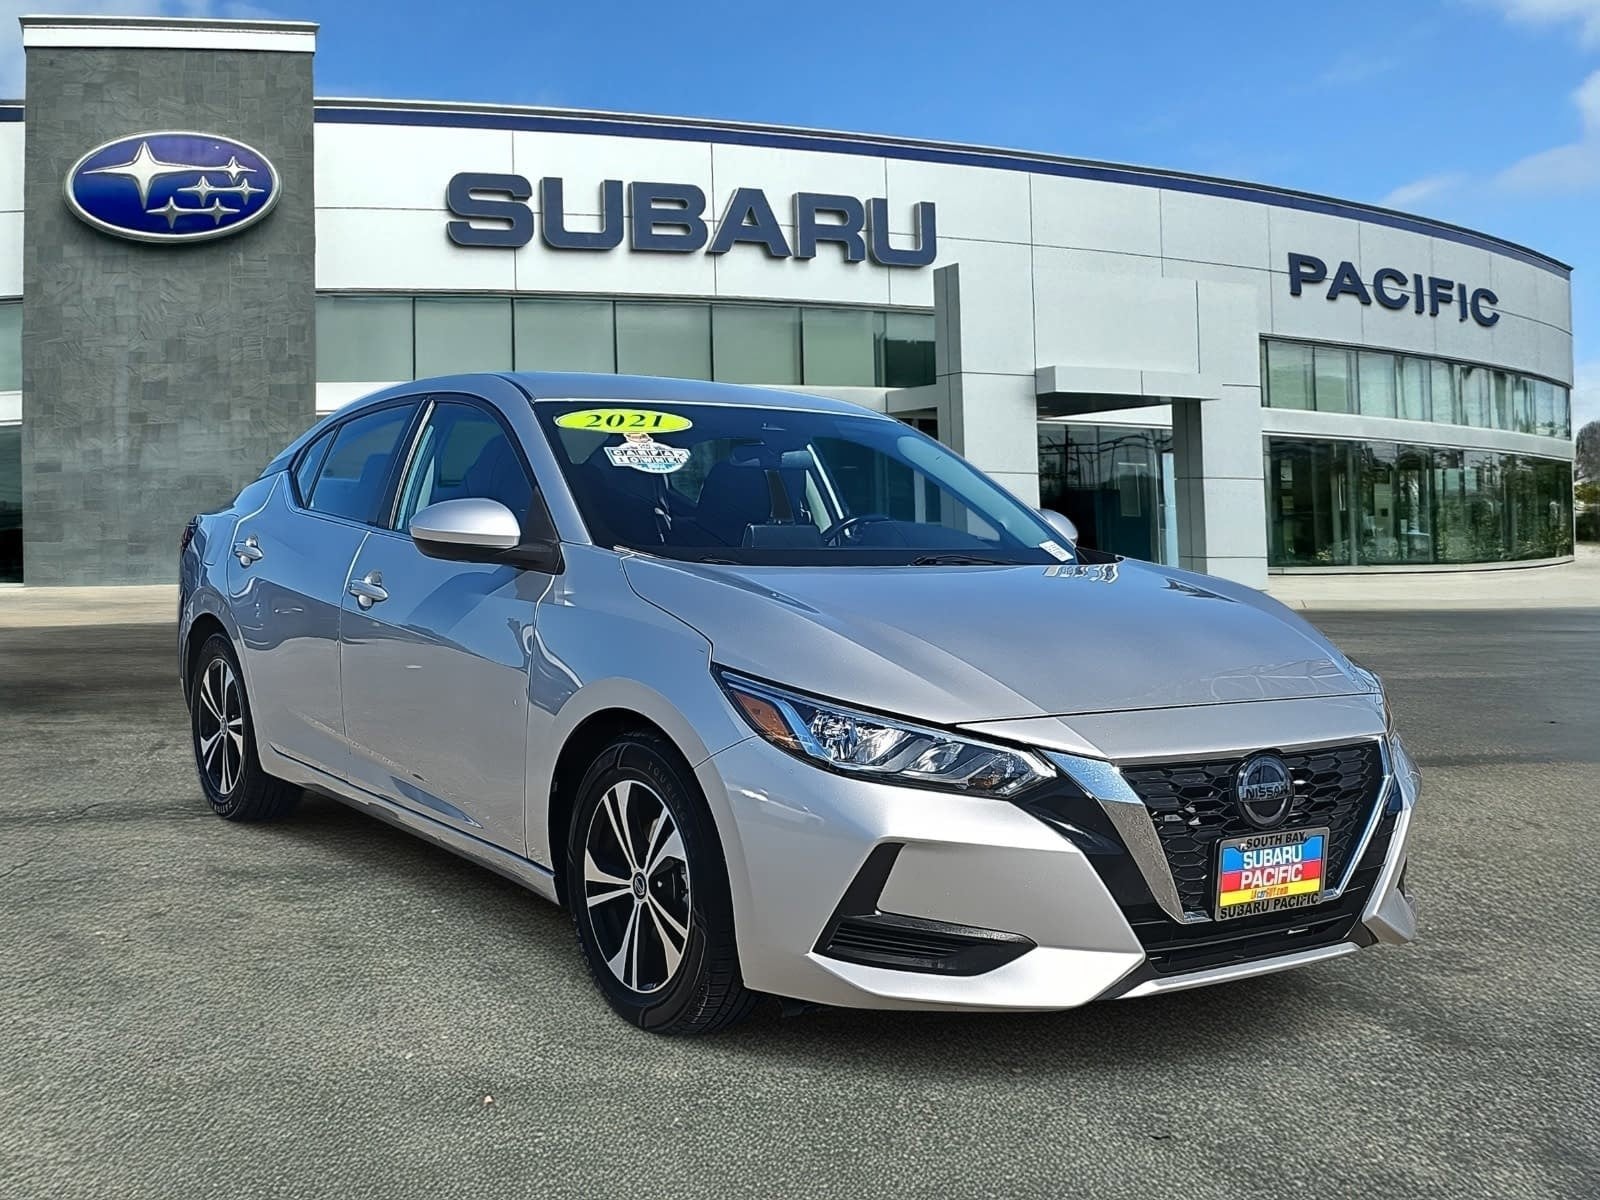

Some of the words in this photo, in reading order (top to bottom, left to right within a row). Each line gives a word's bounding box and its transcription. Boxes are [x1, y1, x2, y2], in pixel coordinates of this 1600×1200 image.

[447, 171, 937, 267] SUBARU
[1288, 252, 1500, 327] PACIFIC
[585, 414, 663, 428] 2021
[1245, 784, 1288, 799] NISSAN
[1246, 834, 1284, 849] SOUTH
[1285, 831, 1306, 844] BAY
[1243, 843, 1302, 870] SUBARU
[1240, 863, 1303, 890] PACIFIC
[1220, 901, 1270, 919] SUBARU
[1273, 892, 1319, 910] PACIFIC
